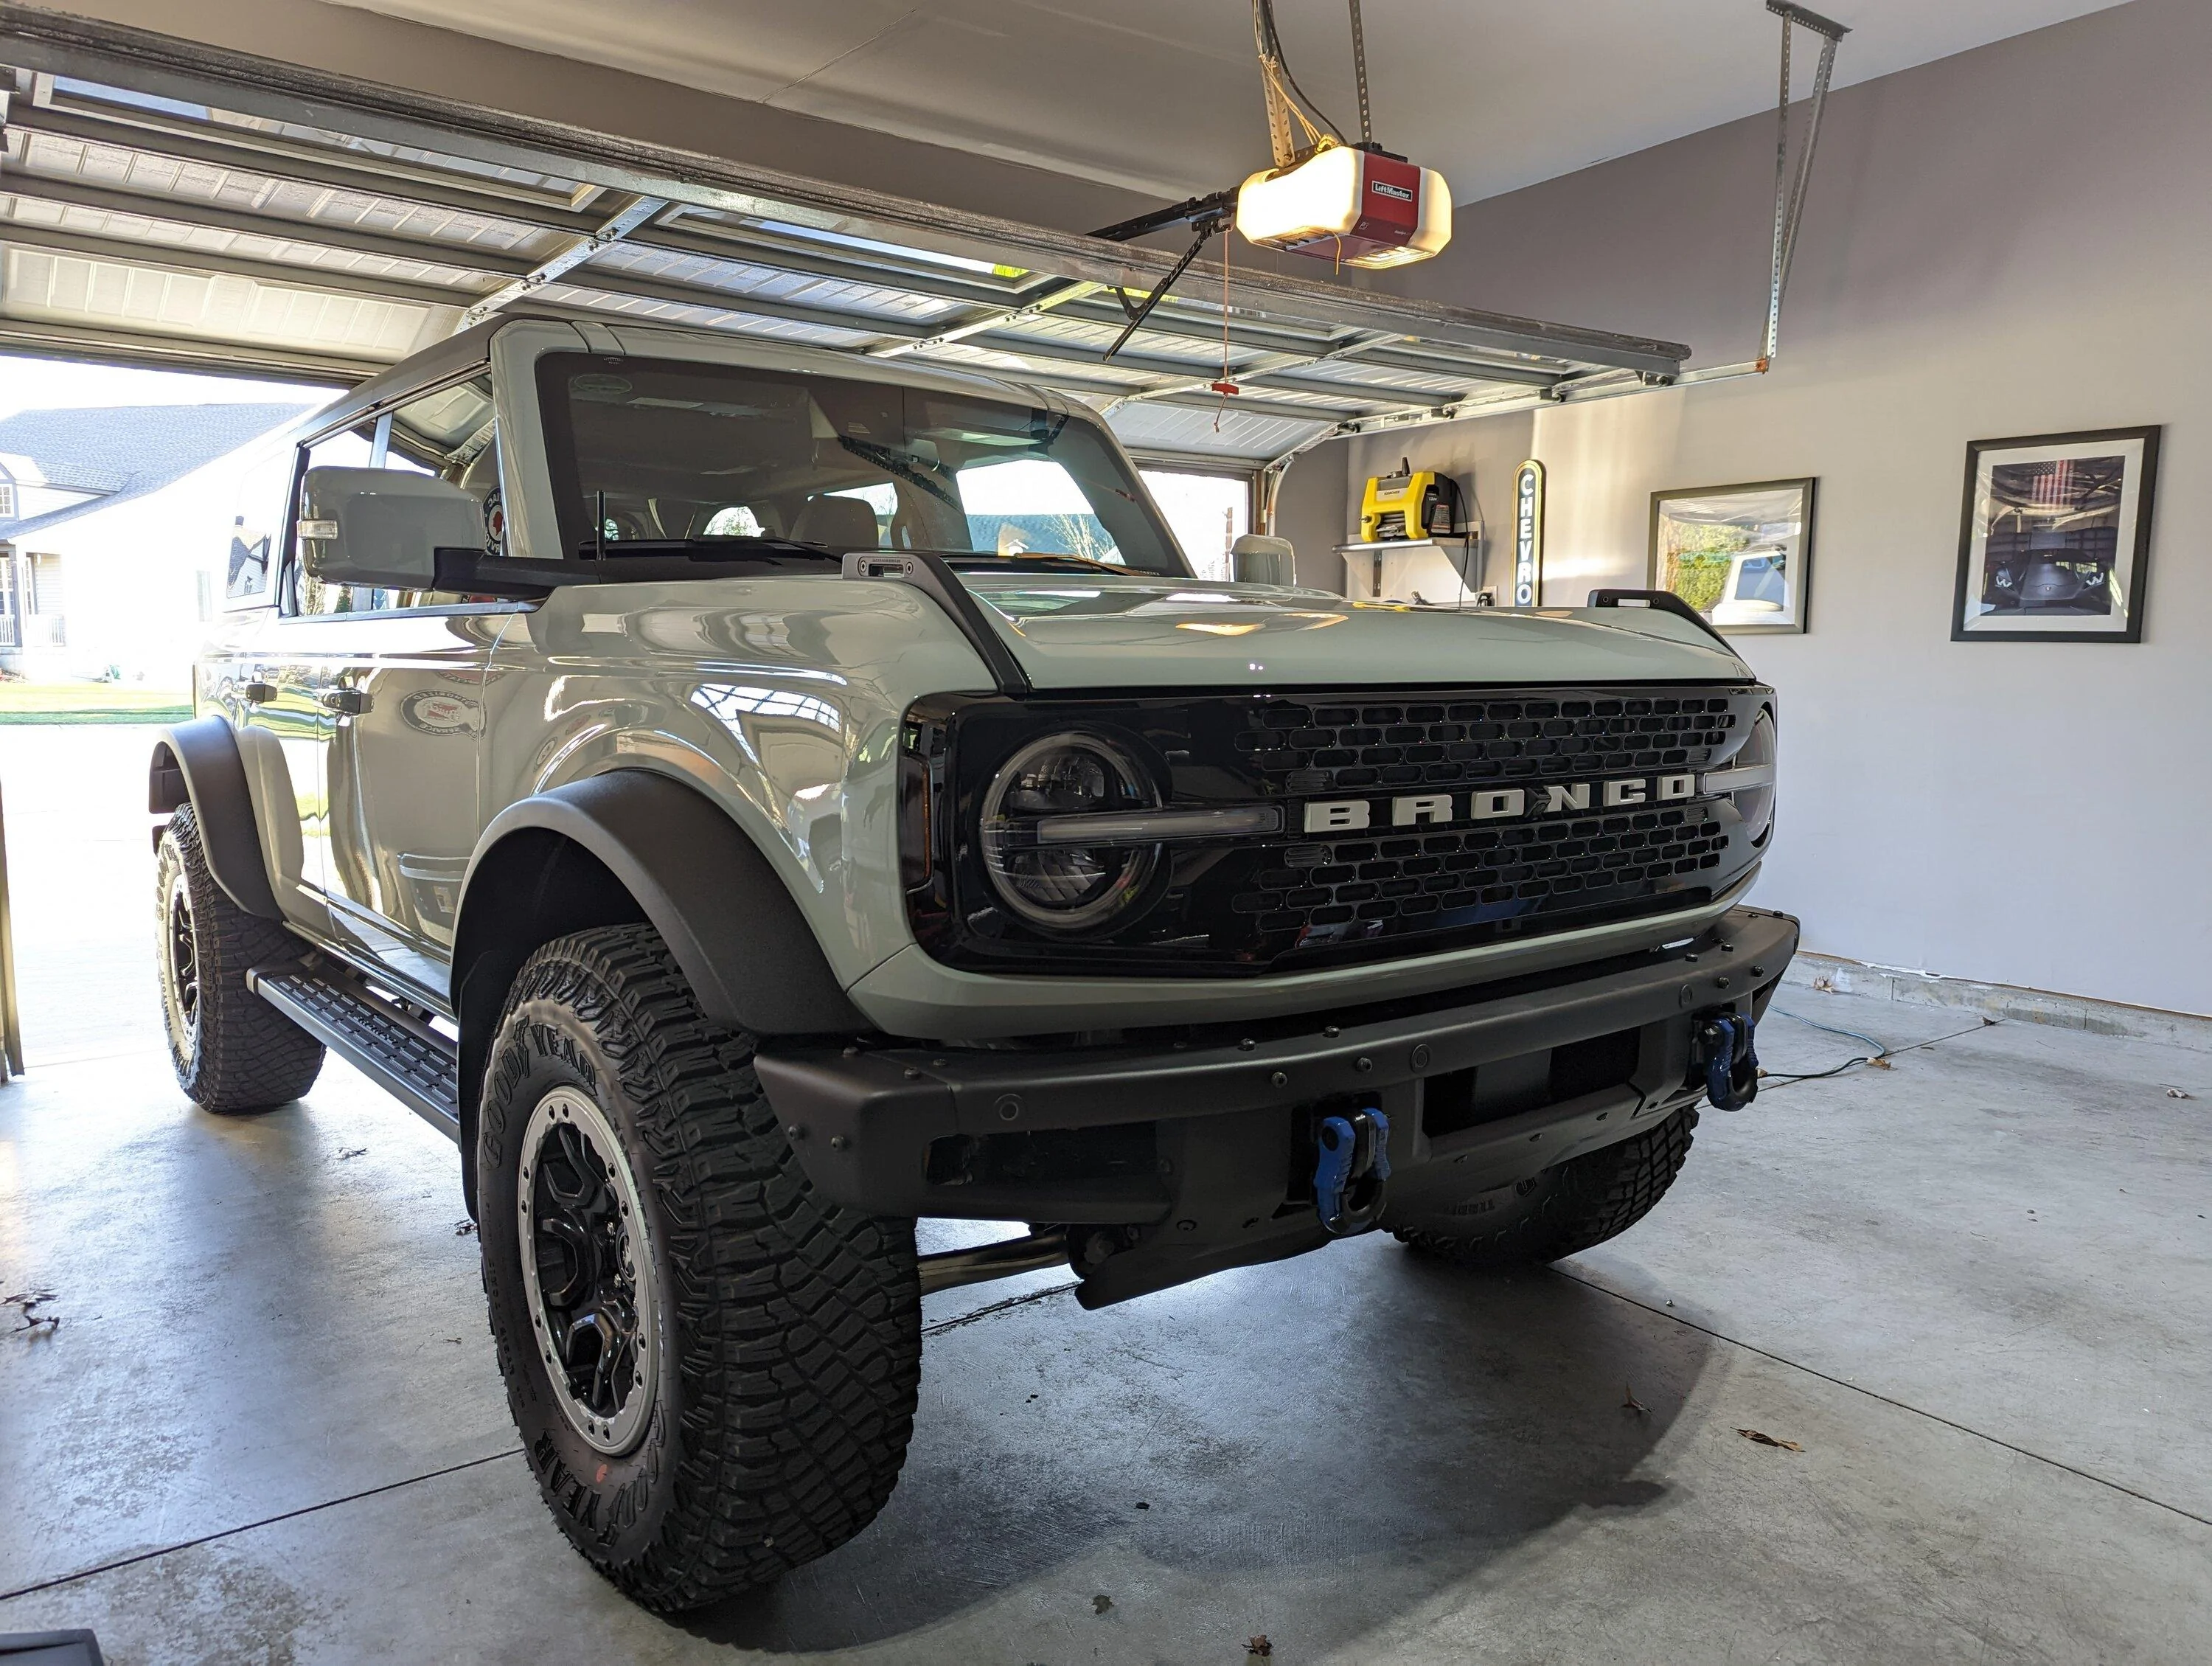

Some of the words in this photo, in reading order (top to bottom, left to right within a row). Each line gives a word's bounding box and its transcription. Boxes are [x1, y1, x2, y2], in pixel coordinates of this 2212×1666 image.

[1375, 184, 1410, 198] LiftMaster
[1517, 473, 1534, 604] CHEVRO
[1304, 773, 1695, 833] BRONCO
